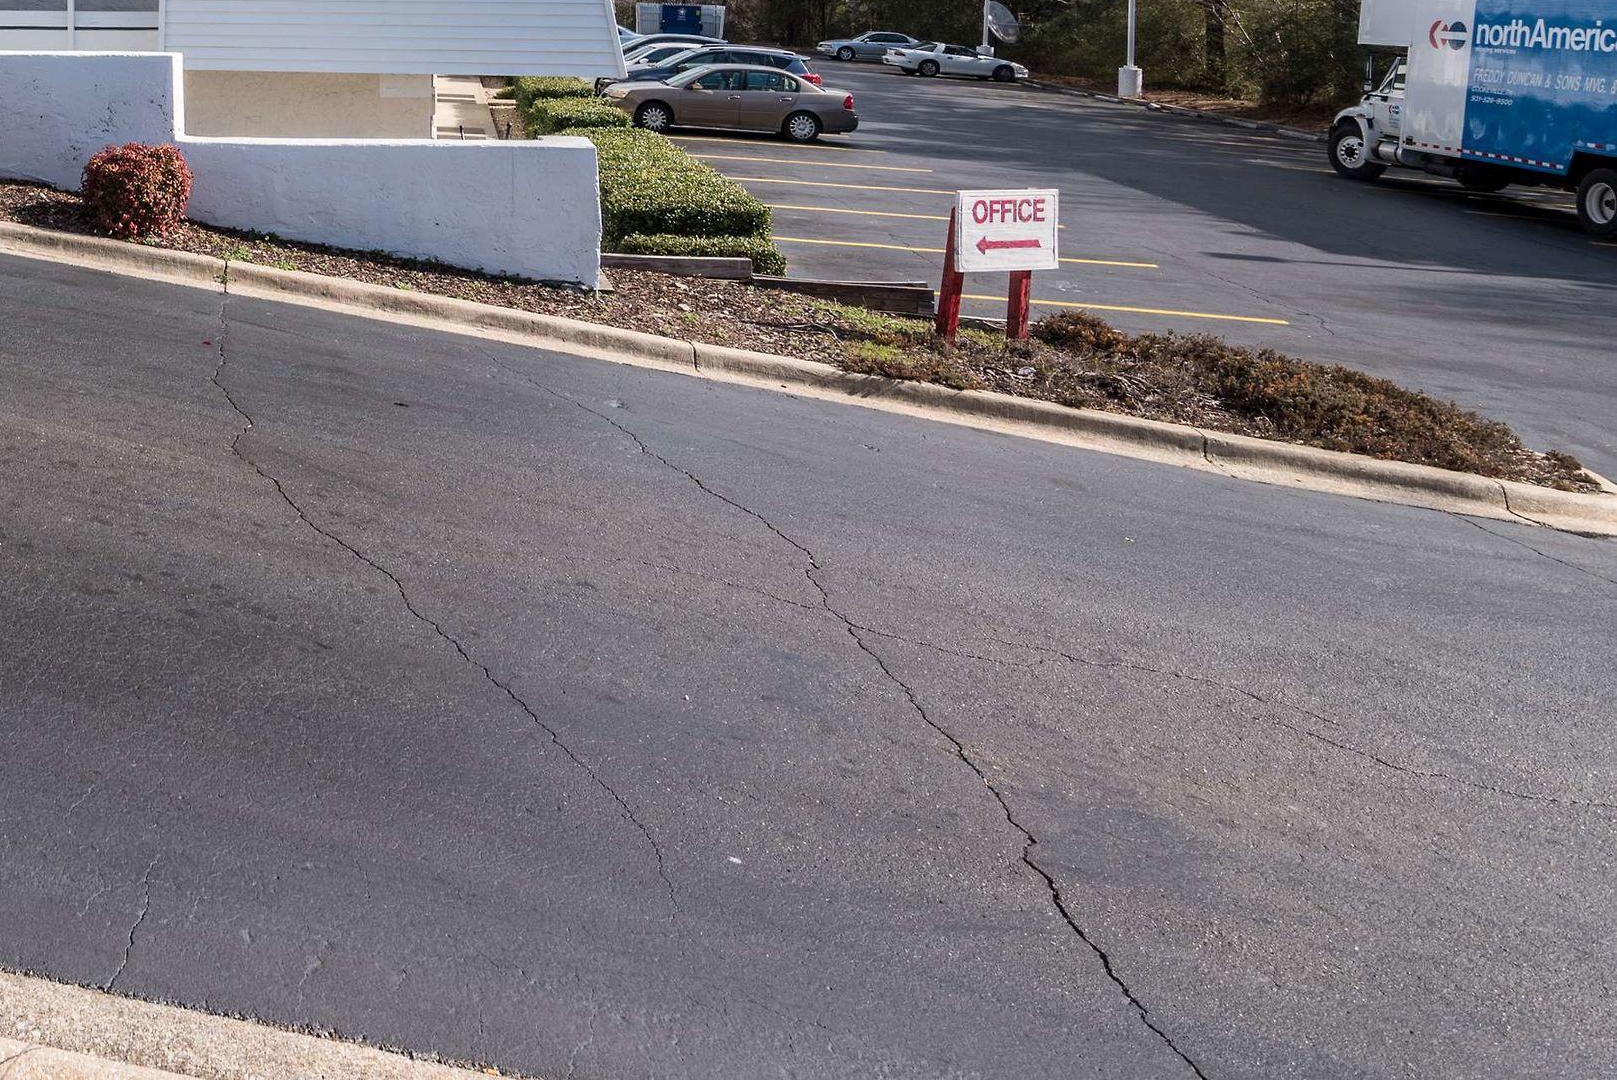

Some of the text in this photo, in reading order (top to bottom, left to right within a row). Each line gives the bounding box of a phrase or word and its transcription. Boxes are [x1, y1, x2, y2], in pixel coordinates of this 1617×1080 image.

[1476, 18, 1617, 52] northAmeric
[1474, 68, 1505, 84] FREDDY
[1507, 71, 1543, 88] DUNCAN
[1555, 74, 1582, 91] SONS
[972, 199, 1045, 224] OFFICE
